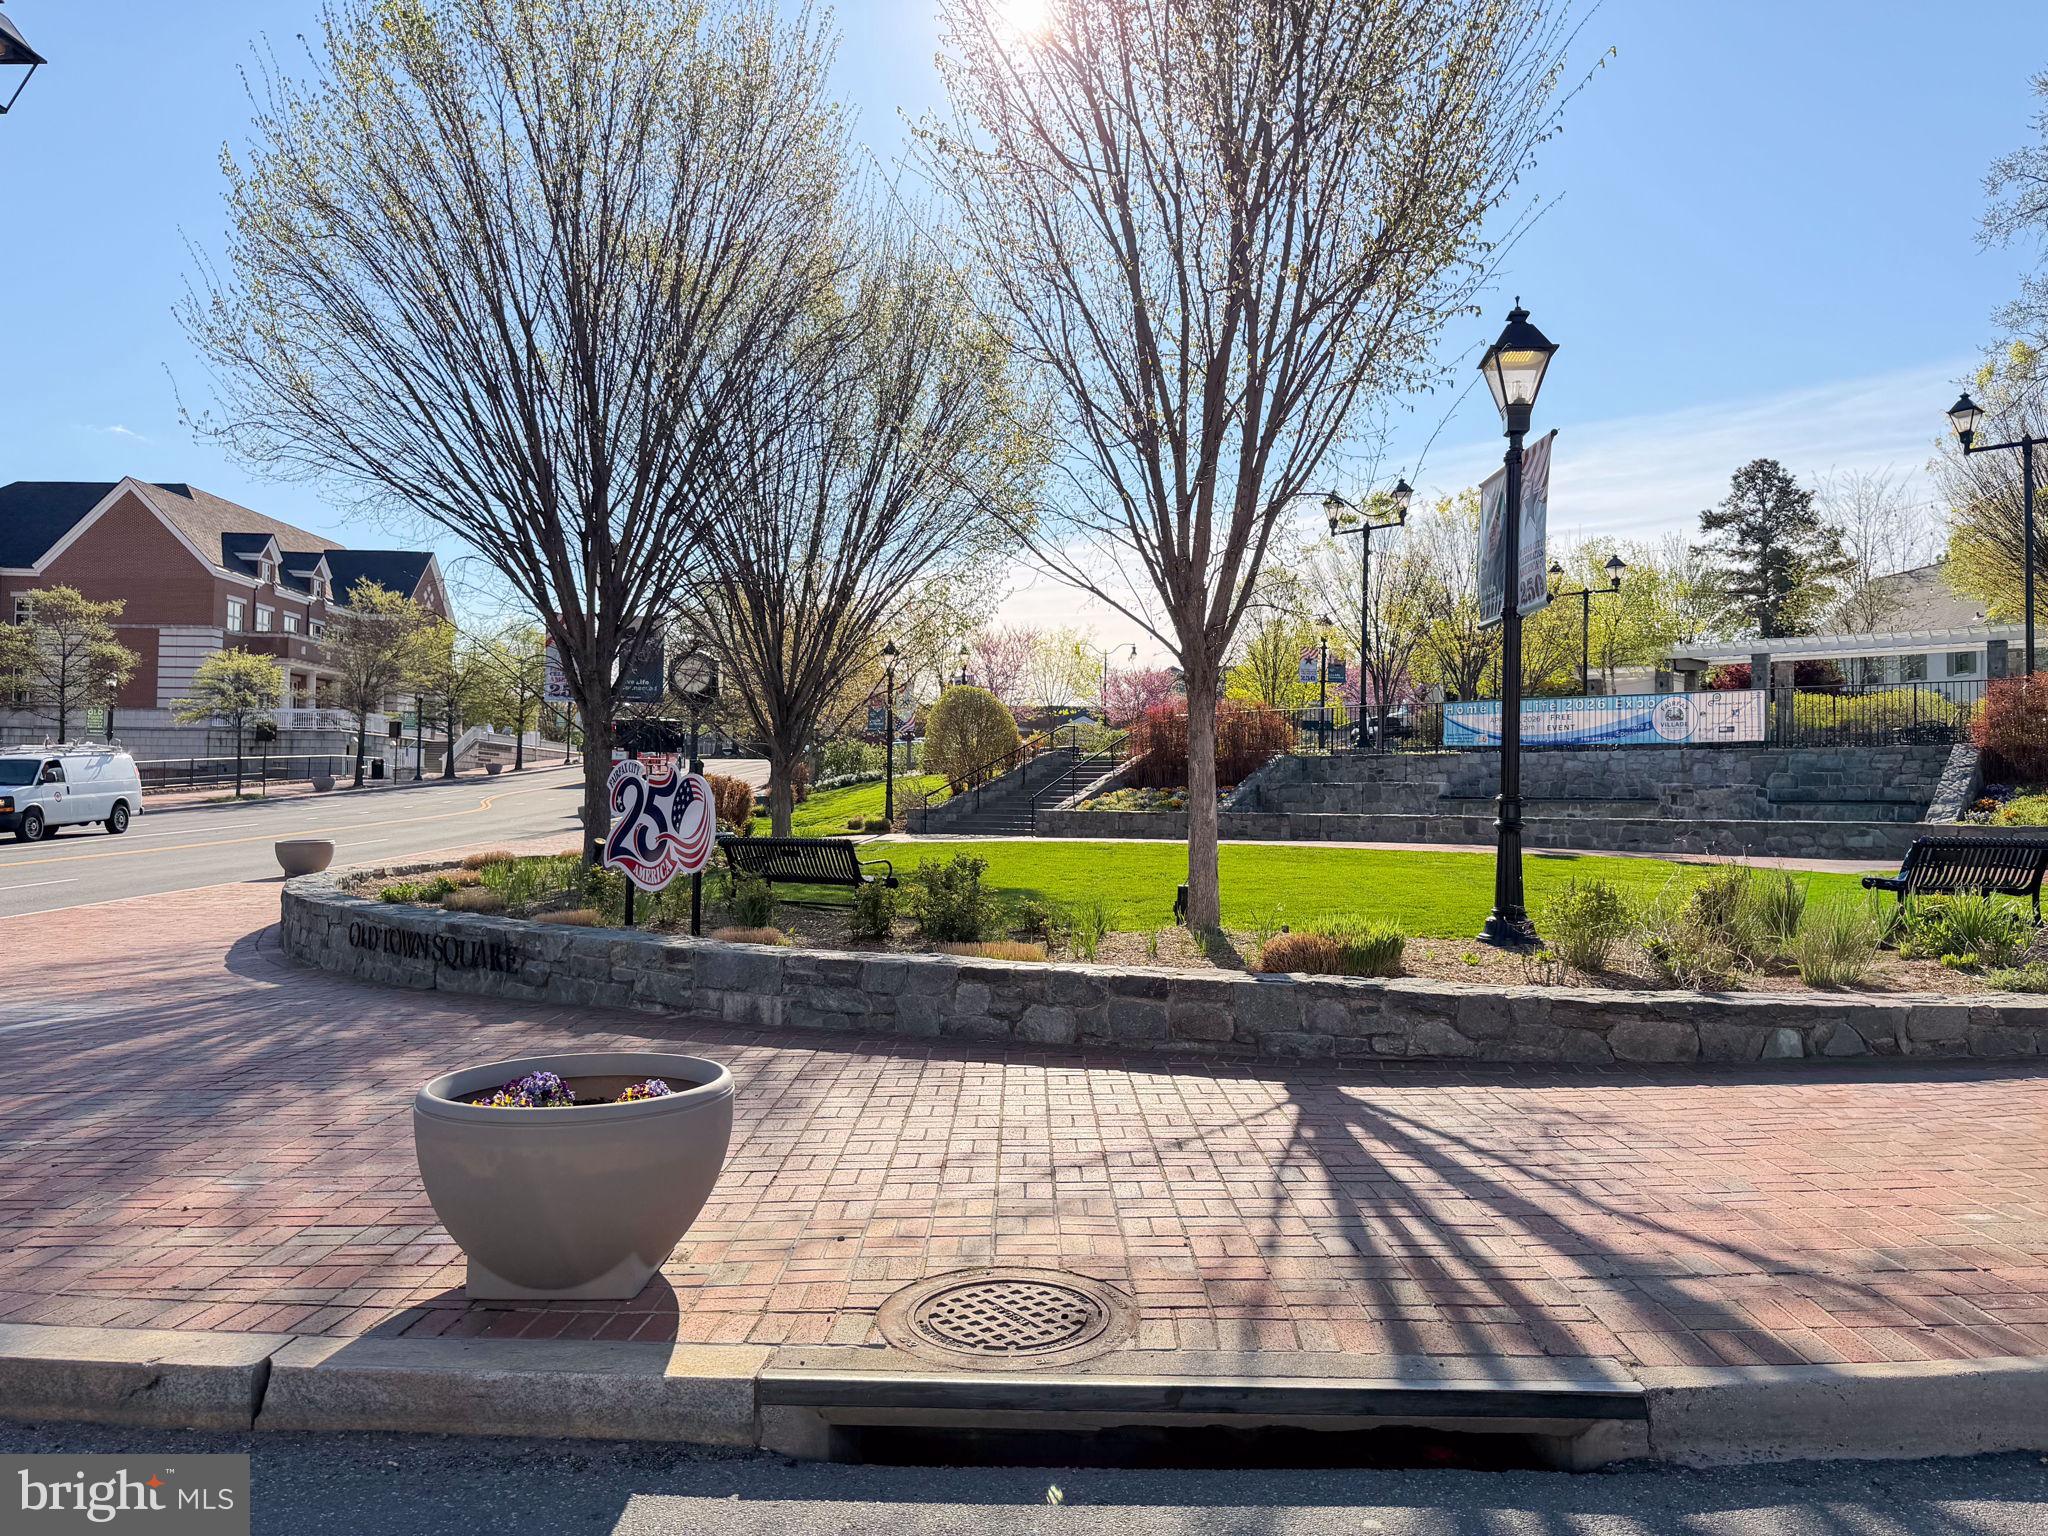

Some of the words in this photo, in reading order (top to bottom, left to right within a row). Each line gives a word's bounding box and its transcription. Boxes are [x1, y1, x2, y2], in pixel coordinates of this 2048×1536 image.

[1520, 574, 1545, 605] 250
[1445, 703, 1487, 714] Home
[1527, 698, 1557, 712] Life
[1564, 698, 1606, 710] 2026
[1660, 700, 1688, 711] FAIRFAX
[609, 761, 628, 788] FAIRFAX
[628, 760, 641, 776] CITY
[607, 766, 712, 870] 250
[633, 860, 674, 885] AMERICA
[349, 921, 379, 951] OLD
[382, 926, 430, 960] TOWN
[431, 934, 519, 974] SQUARE
[989, 1304, 1031, 1327] STORM
